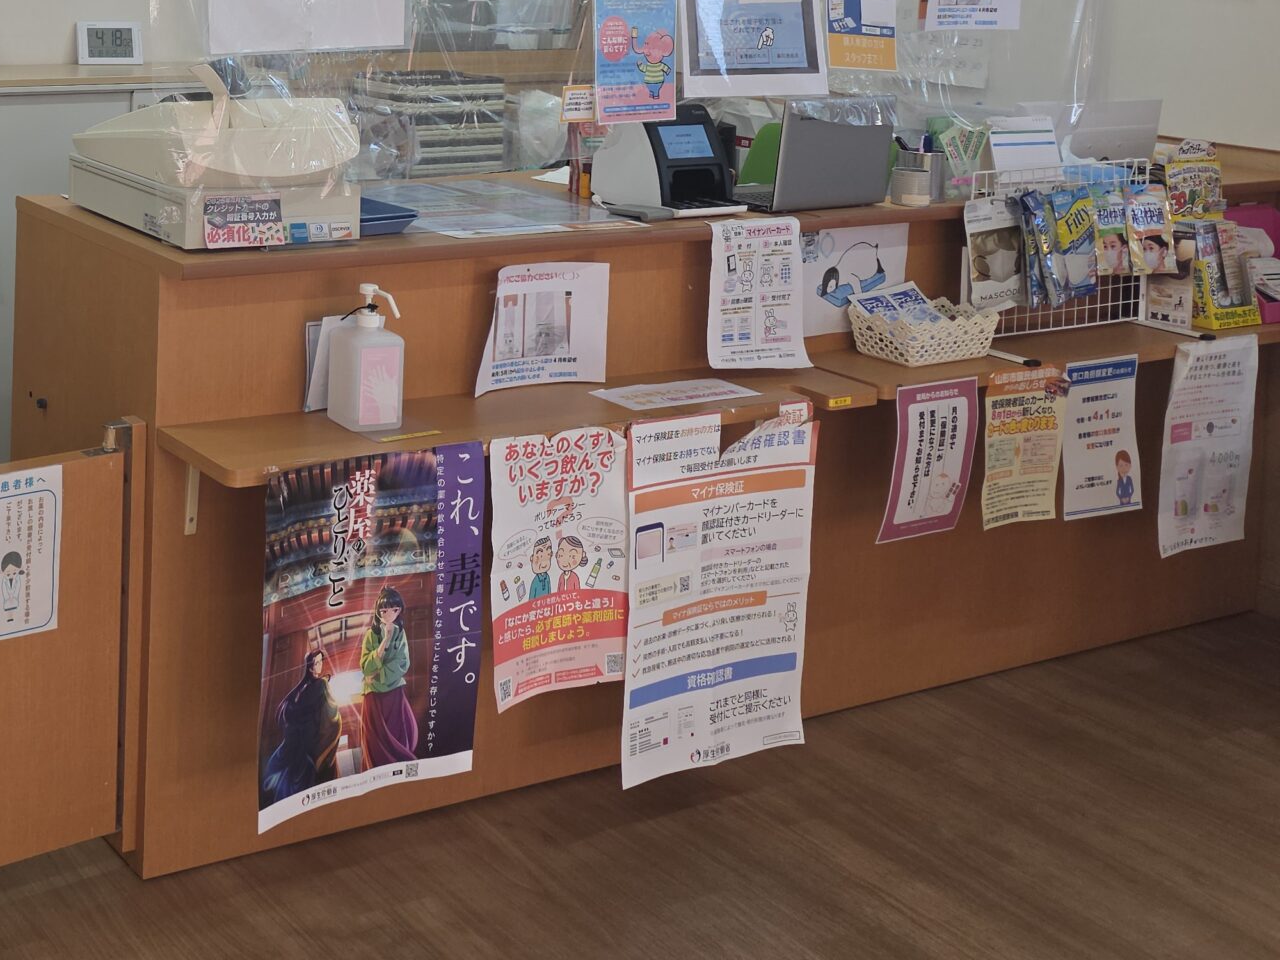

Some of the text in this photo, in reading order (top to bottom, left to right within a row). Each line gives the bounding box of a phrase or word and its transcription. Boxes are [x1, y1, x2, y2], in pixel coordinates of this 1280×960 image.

[206, 203, 269, 214] クレジットカードの
[226, 211, 277, 222] 暗証番号入力が
[1131, 205, 1166, 226] 超快適
[1064, 204, 1092, 236] Fitty
[206, 226, 251, 244] 必須化
[746, 226, 791, 236] マイナンバーカード
[991, 393, 1057, 410] 被保険者証のカードが
[635, 423, 721, 445] マイナ保険証をお持ちの方は
[508, 449, 614, 483] いくつ飲んで
[679, 453, 760, 474] で毎回受付をお願いします
[0, 476, 46, 493] 患者様へ
[691, 480, 745, 500] マイナ保険証
[534, 502, 587, 522] ポリファーマシー
[702, 497, 778, 518] マイナンバーカードを
[538, 511, 584, 532] ってなんだろう
[701, 507, 805, 533] 顔認証付きカードリーダーに
[328, 484, 354, 608] ひとりごと
[701, 528, 757, 545] 置いてください
[723, 542, 777, 557] スマートフォンの場合
[446, 452, 481, 684] これ、毒です。
[522, 626, 590, 651] 相談しましょう。
[687, 667, 733, 690] 資格確認書
[708, 688, 769, 712] これまでと同様に
[708, 695, 792, 725] 受付にてご提示ください
